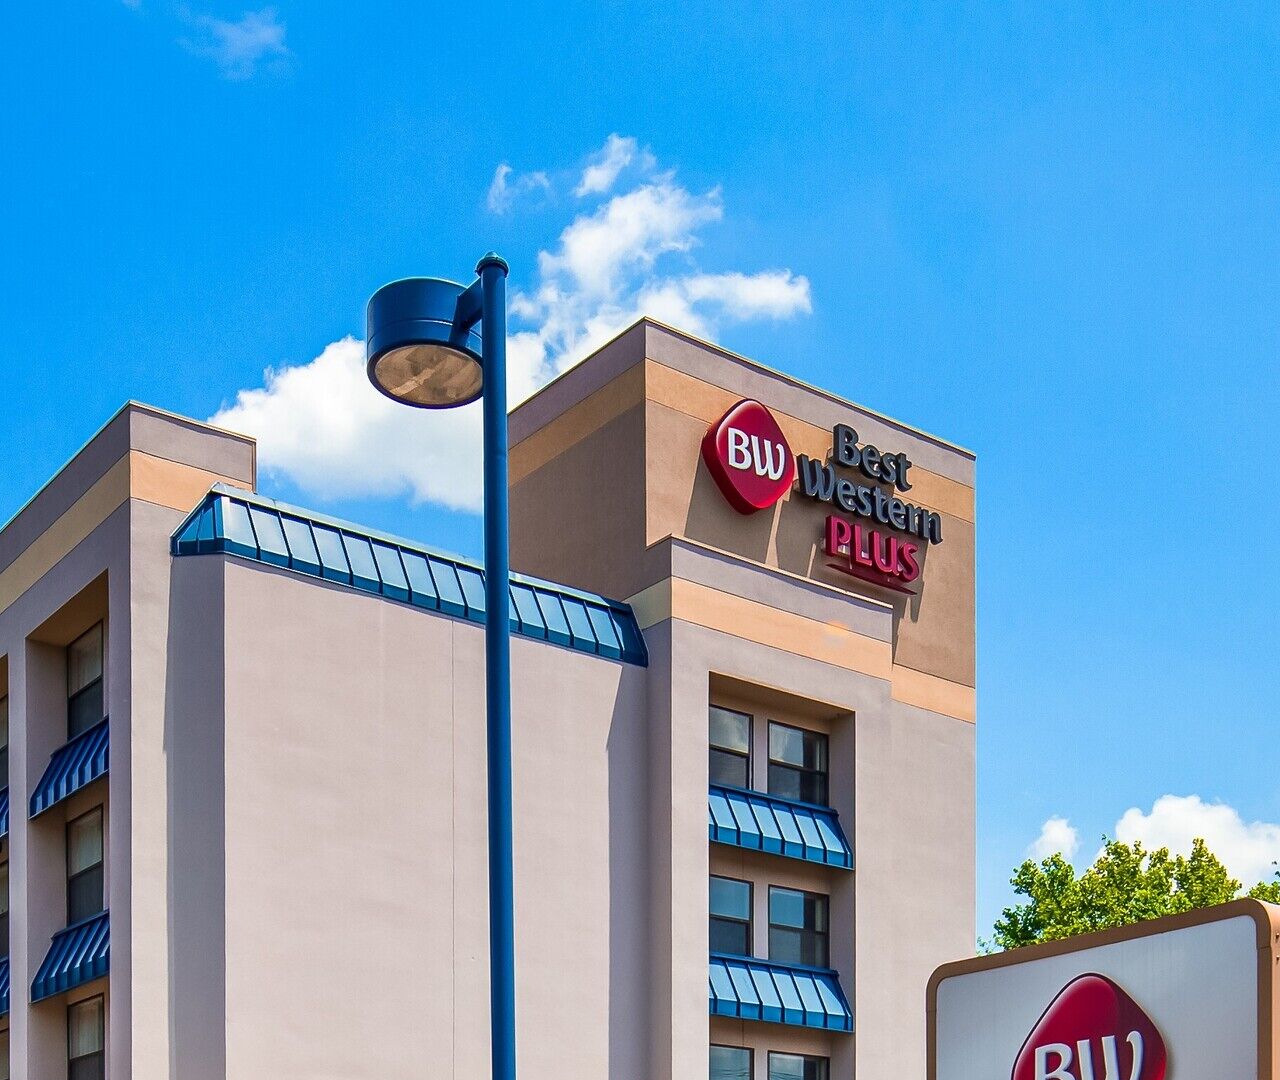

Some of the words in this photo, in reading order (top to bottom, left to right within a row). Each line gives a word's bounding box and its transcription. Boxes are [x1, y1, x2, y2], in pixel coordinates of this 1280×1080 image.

[727, 426, 786, 482] BW
[832, 423, 913, 493] Best
[796, 453, 944, 545] Western
[824, 515, 920, 583] PLUS
